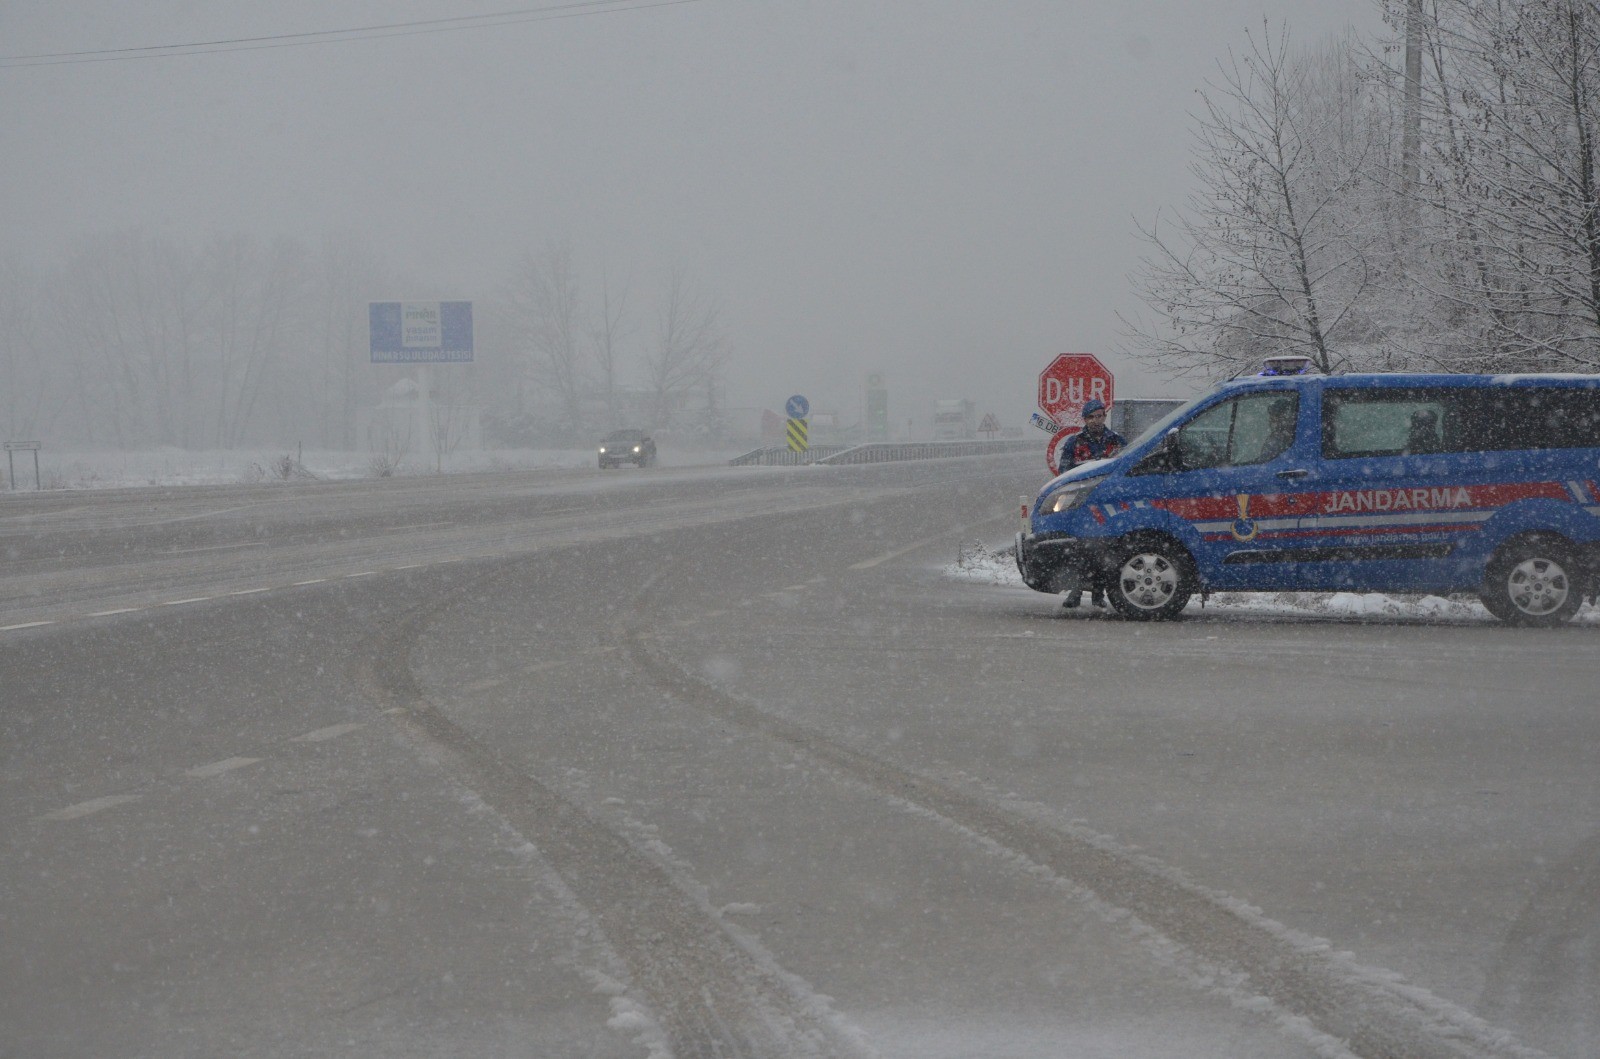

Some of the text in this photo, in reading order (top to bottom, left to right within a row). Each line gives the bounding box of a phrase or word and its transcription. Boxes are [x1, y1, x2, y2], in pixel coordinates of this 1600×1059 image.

[1046, 377, 1106, 404] DUR
[1324, 487, 1472, 513] JANDARMA
[1344, 532, 1450, 546] www.jandarma.gov.tr
